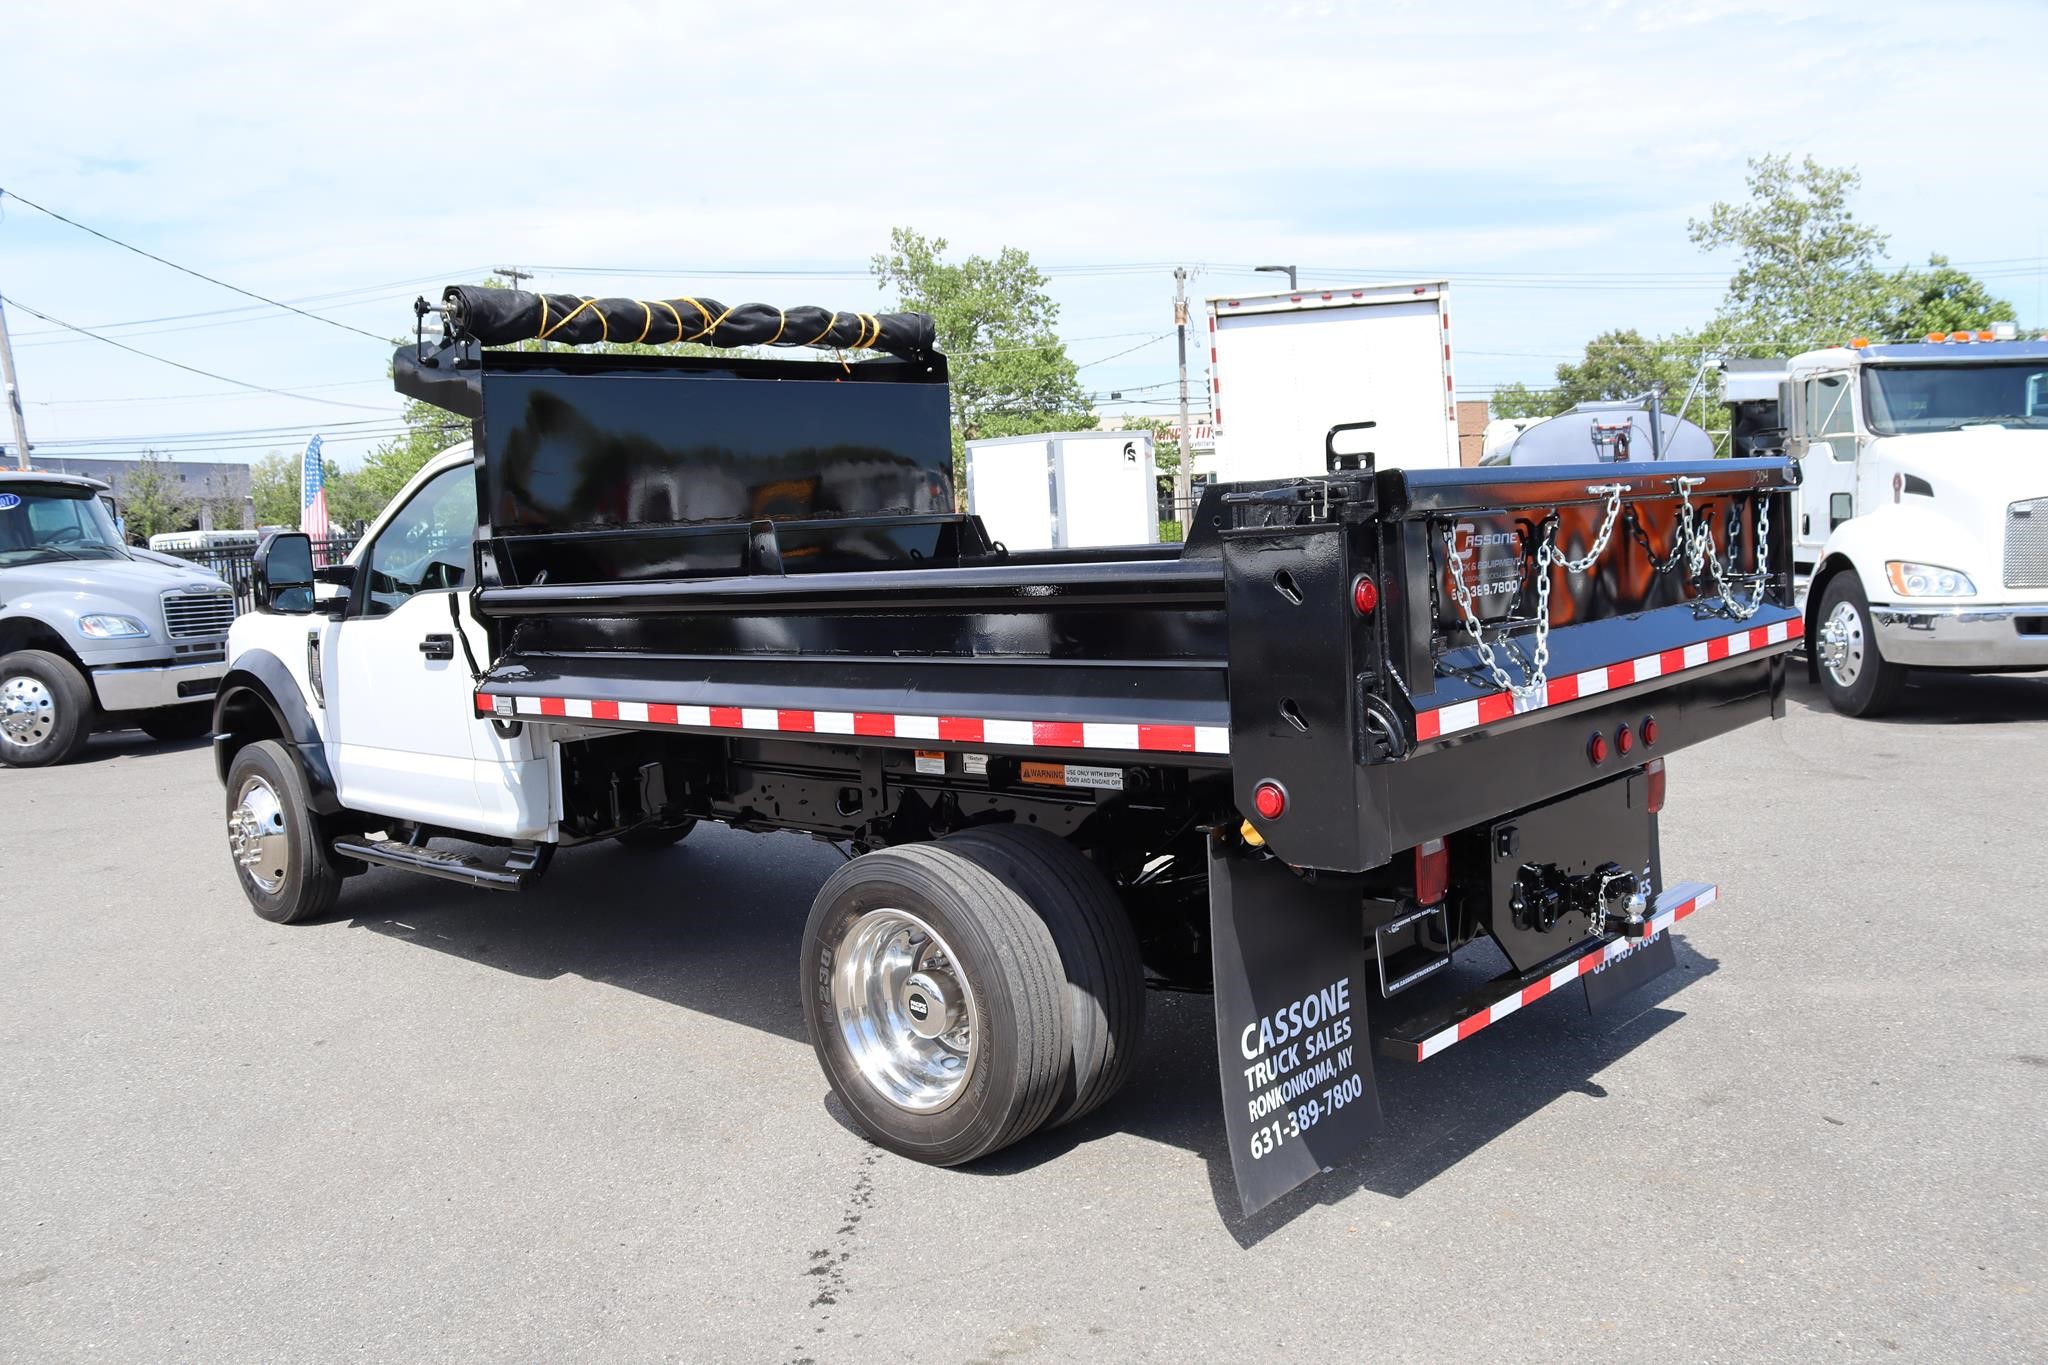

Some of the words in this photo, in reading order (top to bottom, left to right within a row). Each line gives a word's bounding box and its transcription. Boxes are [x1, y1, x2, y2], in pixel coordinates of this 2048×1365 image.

[1451, 580, 1518, 601] 6389.7800
[1030, 768, 1064, 779] WARNING
[1066, 776, 1080, 784] BODY
[1076, 769, 1090, 777] ONLY
[1103, 771, 1120, 779] EMPTY
[1241, 977, 1351, 1061] CASSONE
[1244, 1042, 1302, 1093] TRUCK
[1305, 1016, 1352, 1061] SALES
[1248, 1060, 1338, 1123] RONKONKOMA,
[1338, 1045, 1354, 1073] NY
[1250, 1073, 1363, 1161] 631-389-7800
